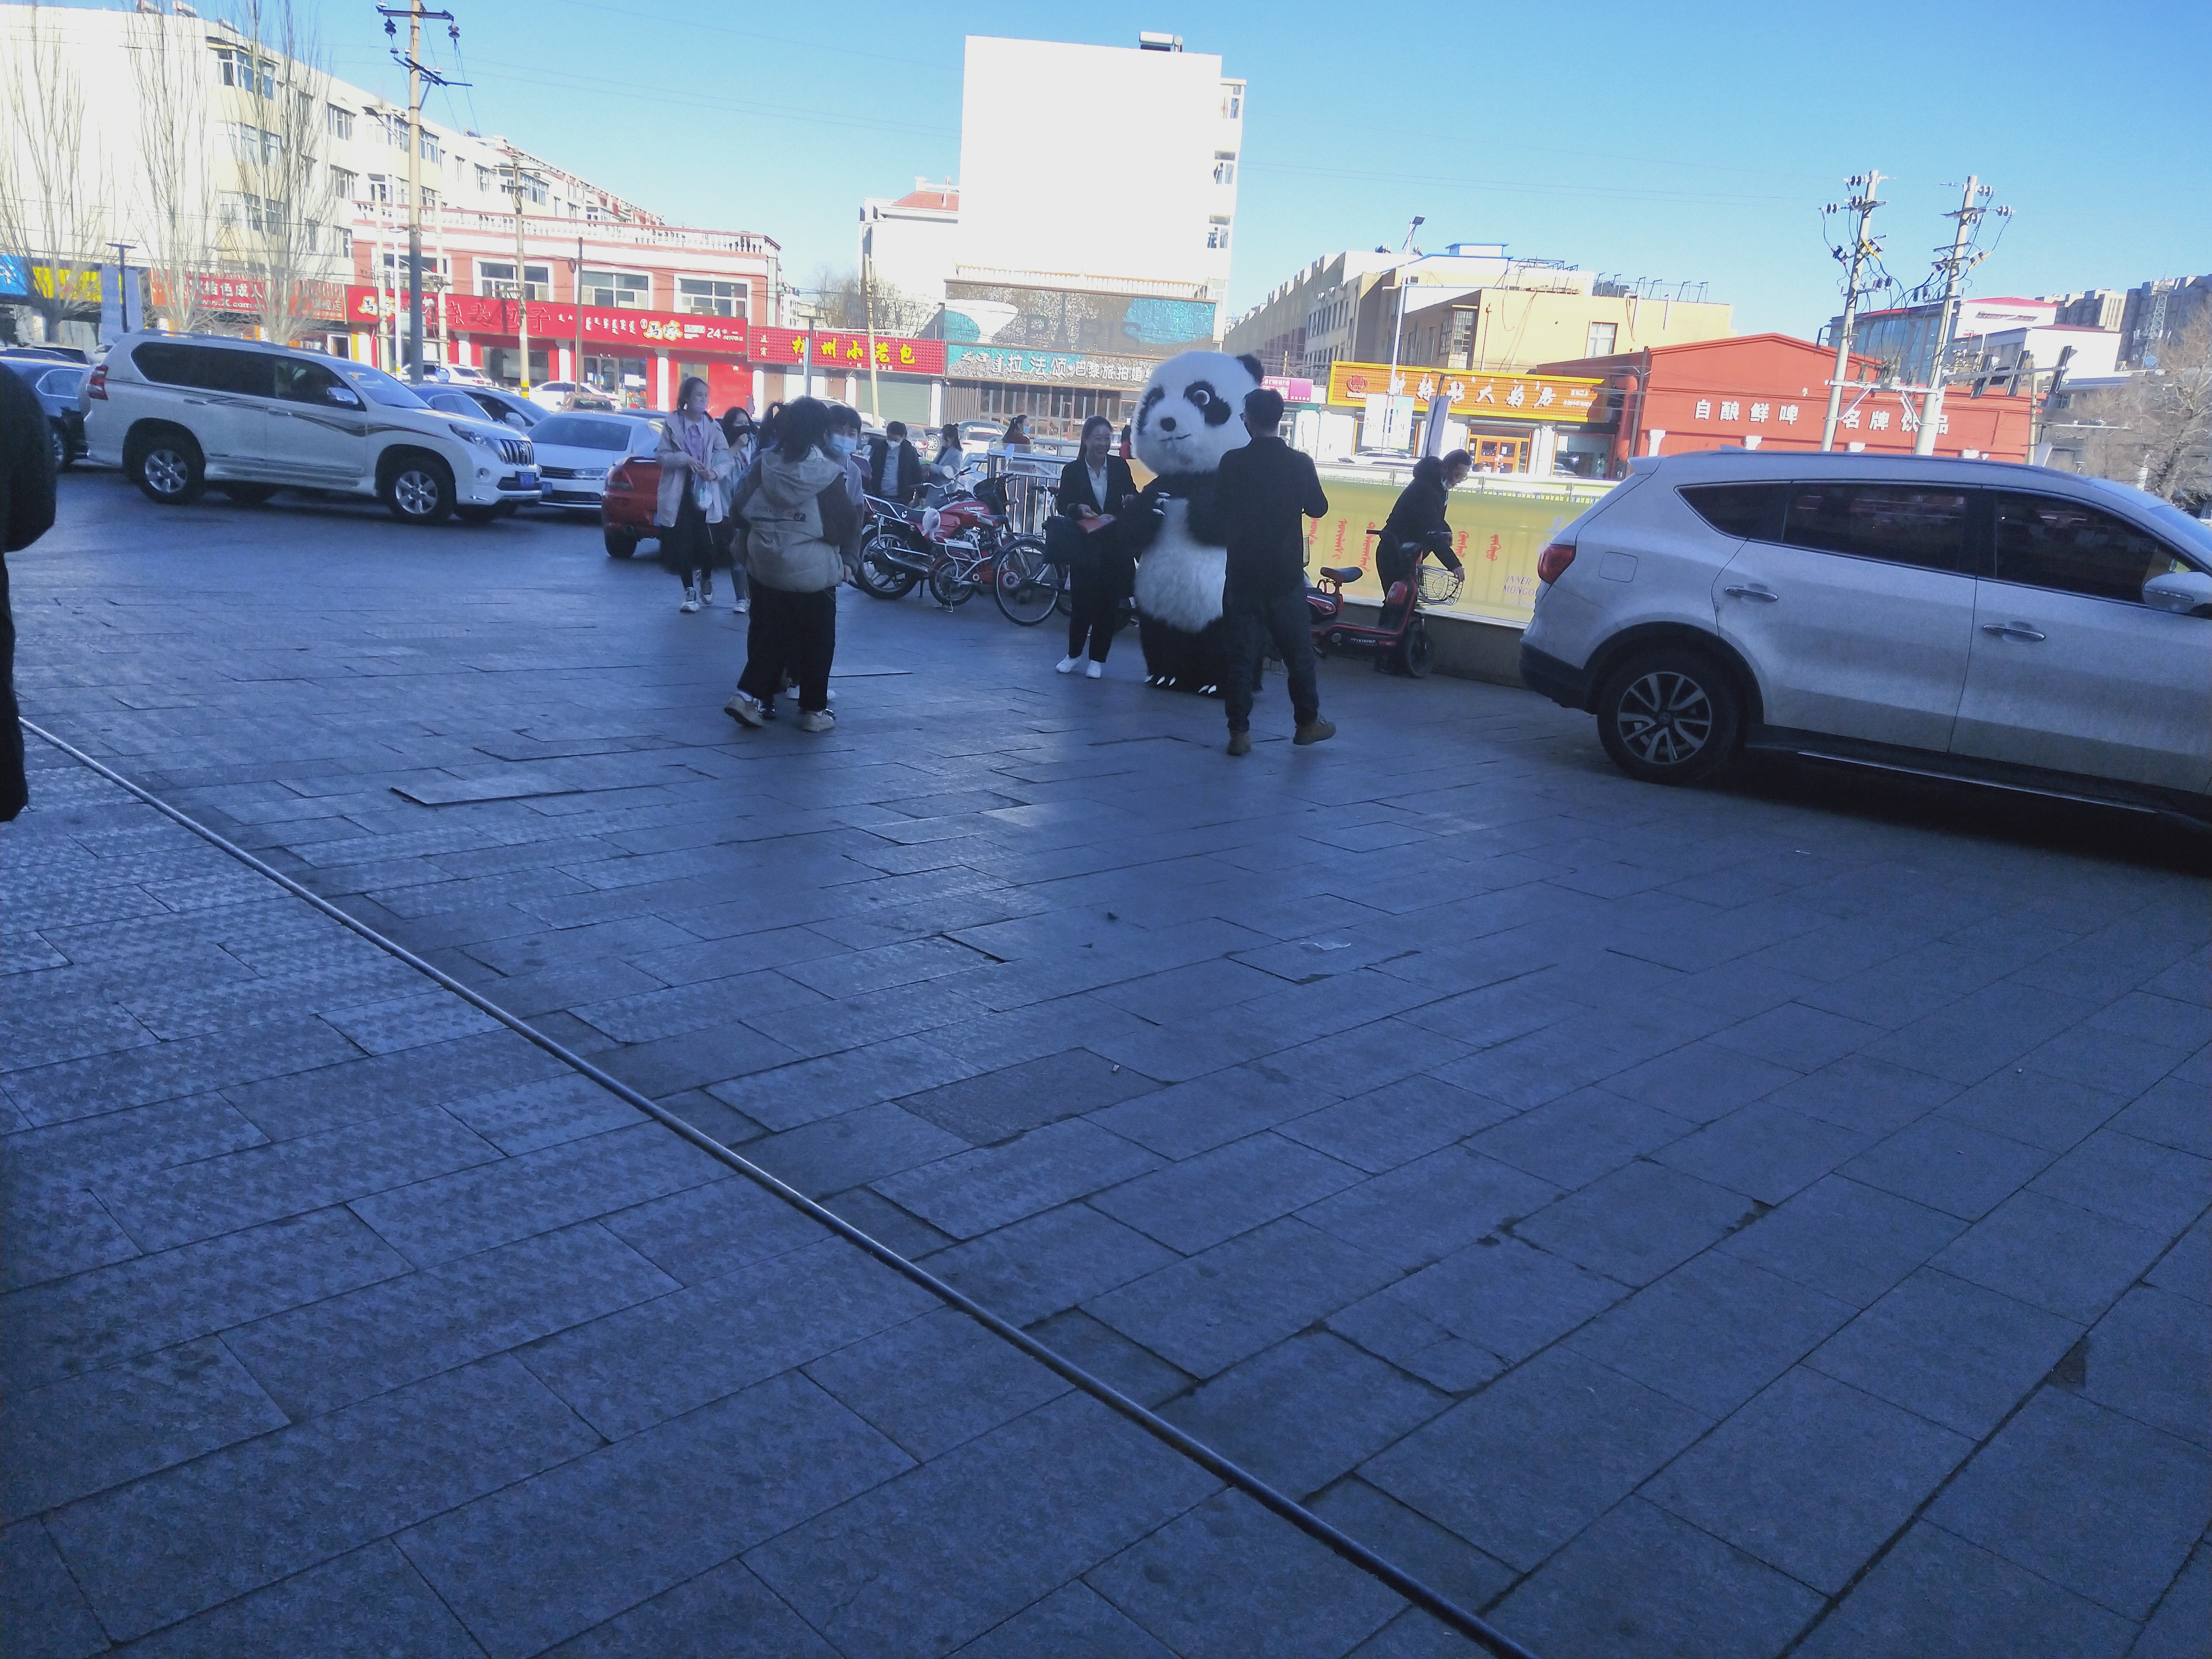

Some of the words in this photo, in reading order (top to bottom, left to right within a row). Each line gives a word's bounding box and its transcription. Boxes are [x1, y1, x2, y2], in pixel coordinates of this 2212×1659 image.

[643, 320, 683, 341] 马家
[1694, 399, 1799, 425] 自酿鲜啤
[1506, 575, 1532, 586] INNER
[1503, 584, 1536, 596] MONGO
